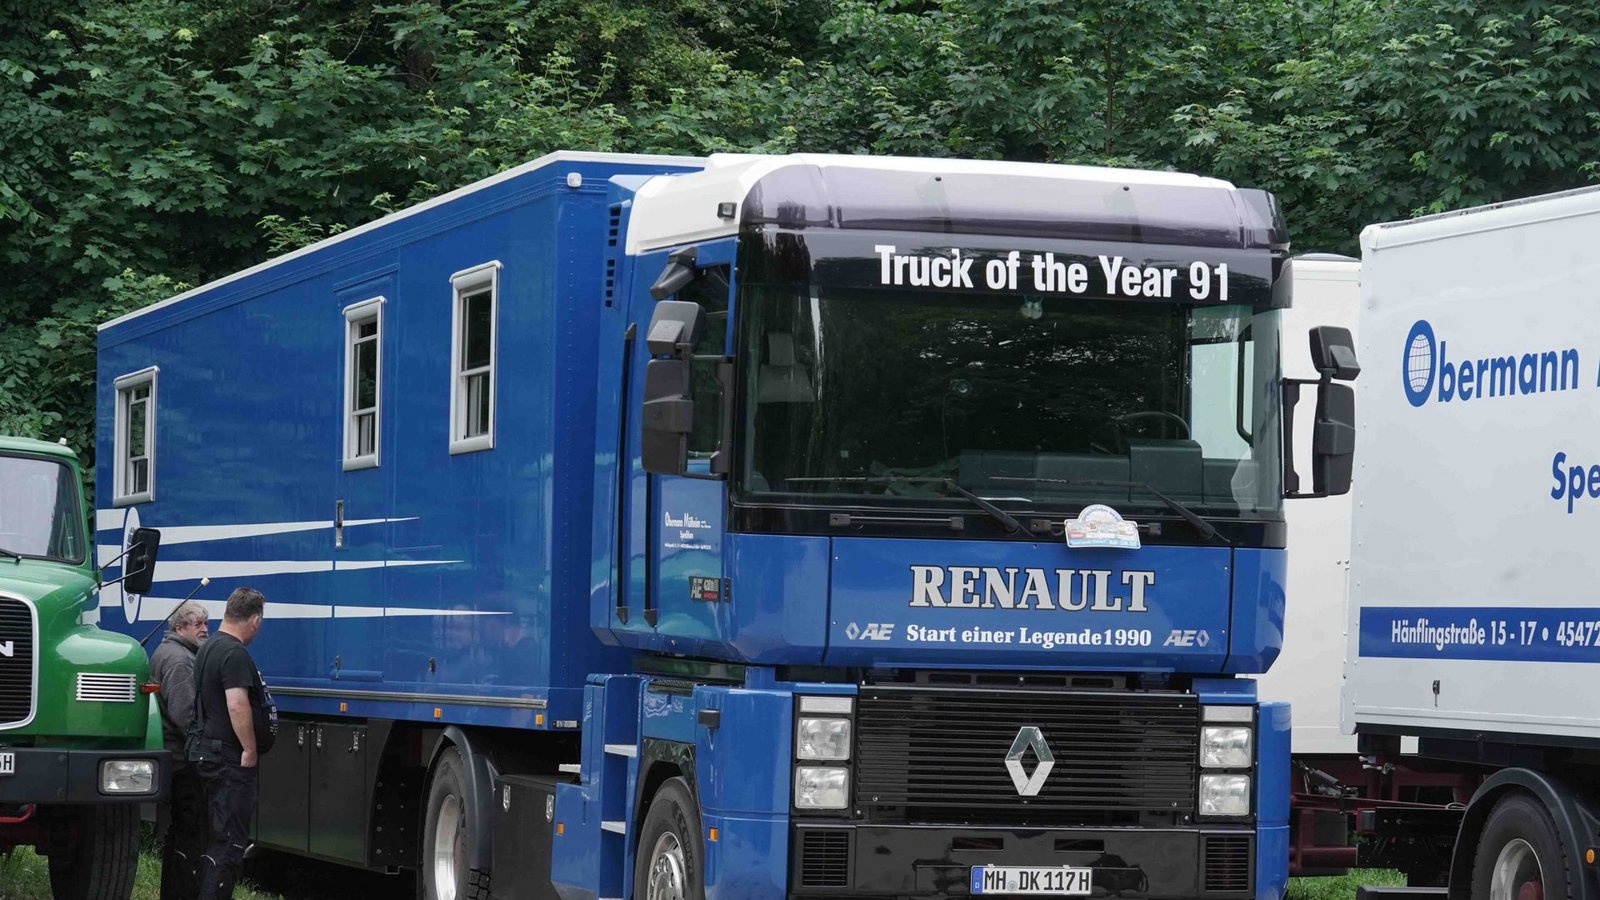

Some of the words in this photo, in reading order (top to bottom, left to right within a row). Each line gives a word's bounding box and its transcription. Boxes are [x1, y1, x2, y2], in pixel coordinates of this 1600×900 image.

[875, 244, 974, 289] Truck
[986, 251, 1021, 290] of
[1032, 252, 1088, 293] the
[1098, 255, 1178, 298] Year
[1189, 260, 1229, 300] 91
[1402, 319, 1580, 408] Obermann
[909, 565, 1156, 612] RENAULT
[859, 622, 895, 641] AE
[906, 624, 957, 644] Start
[962, 626, 1015, 645] einer
[1162, 629, 1197, 647] AE
[1391, 618, 1486, 651] Hänflingstraße
[1491, 620, 1507, 646] 15
[1520, 621, 1537, 646] 17
[984, 870, 1007, 890] MH
